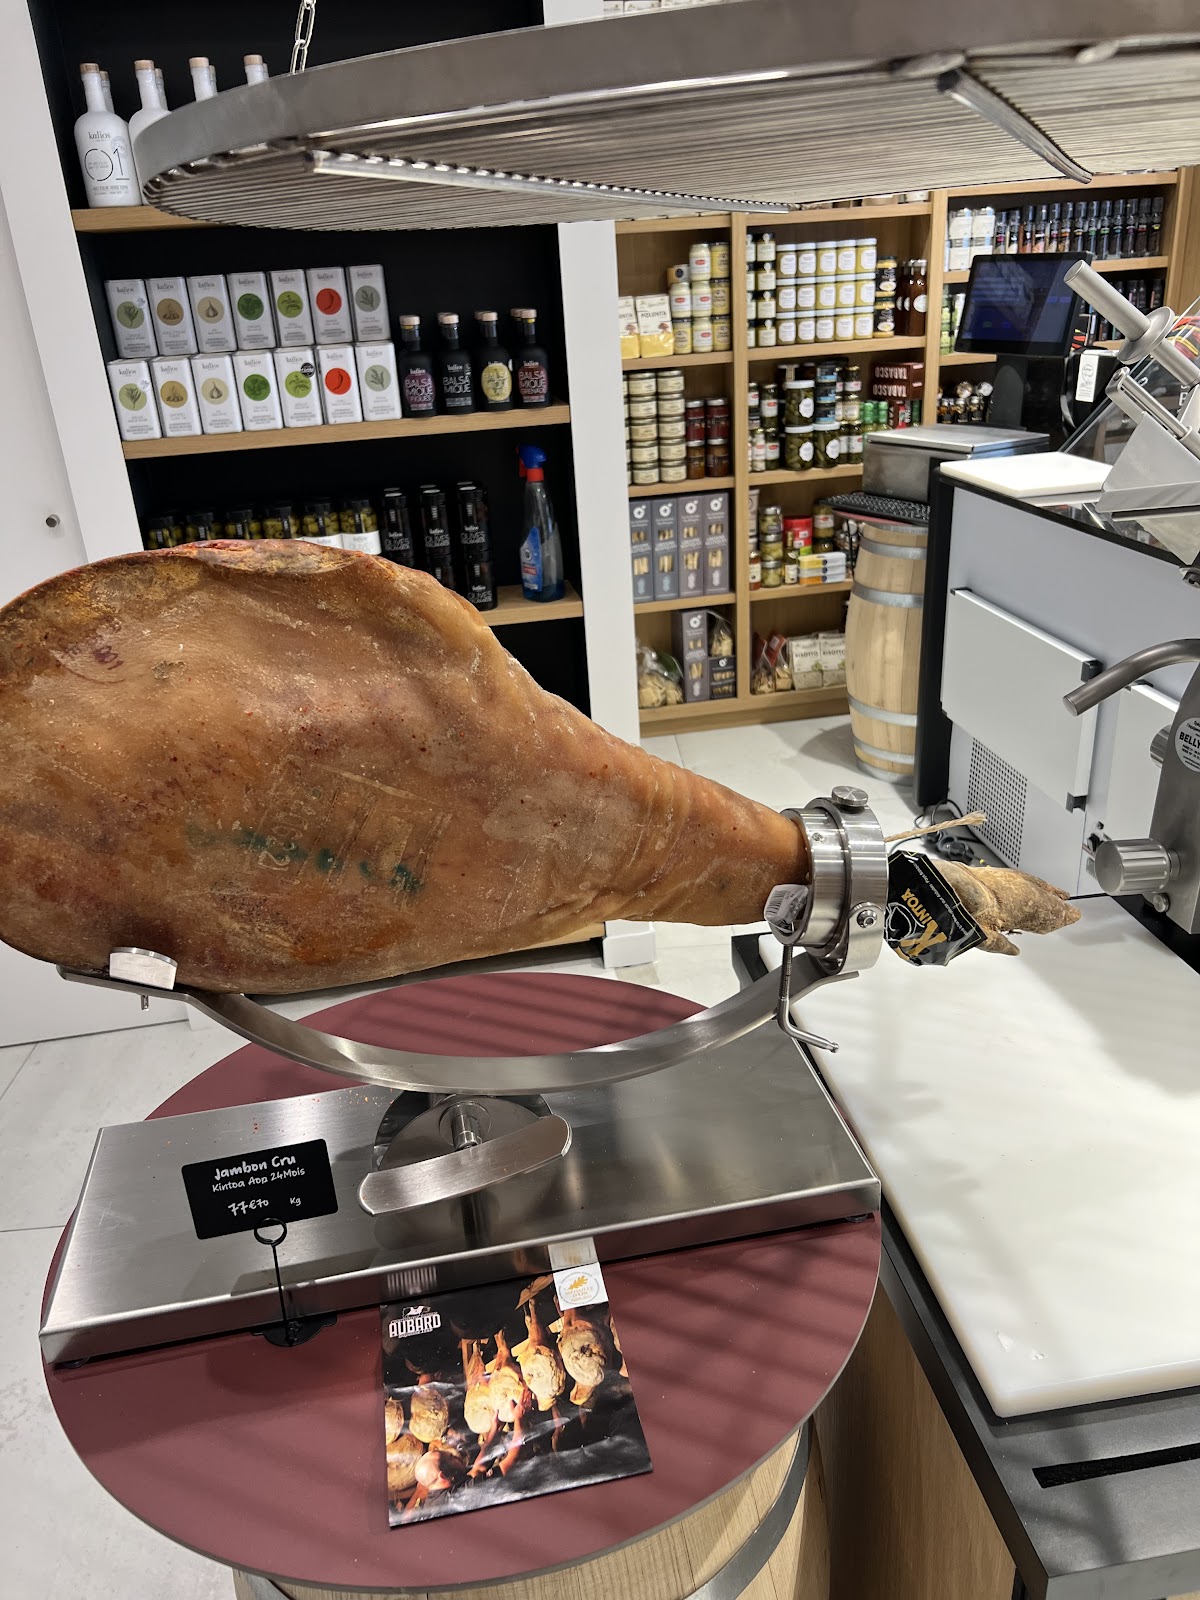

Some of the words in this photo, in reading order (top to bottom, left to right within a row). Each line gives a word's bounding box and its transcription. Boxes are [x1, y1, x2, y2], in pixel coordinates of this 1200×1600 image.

[874, 366, 908, 379] TABASCO
[873, 384, 907, 397] TABASCO
[901, 888, 947, 957] KINTOA
[214, 1160, 268, 1180] Jambon
[271, 1155, 296, 1167] Cru
[212, 1178, 245, 1193] Kintoa
[290, 1196, 301, 1206] Kg
[388, 1314, 441, 1338] AUBARD
